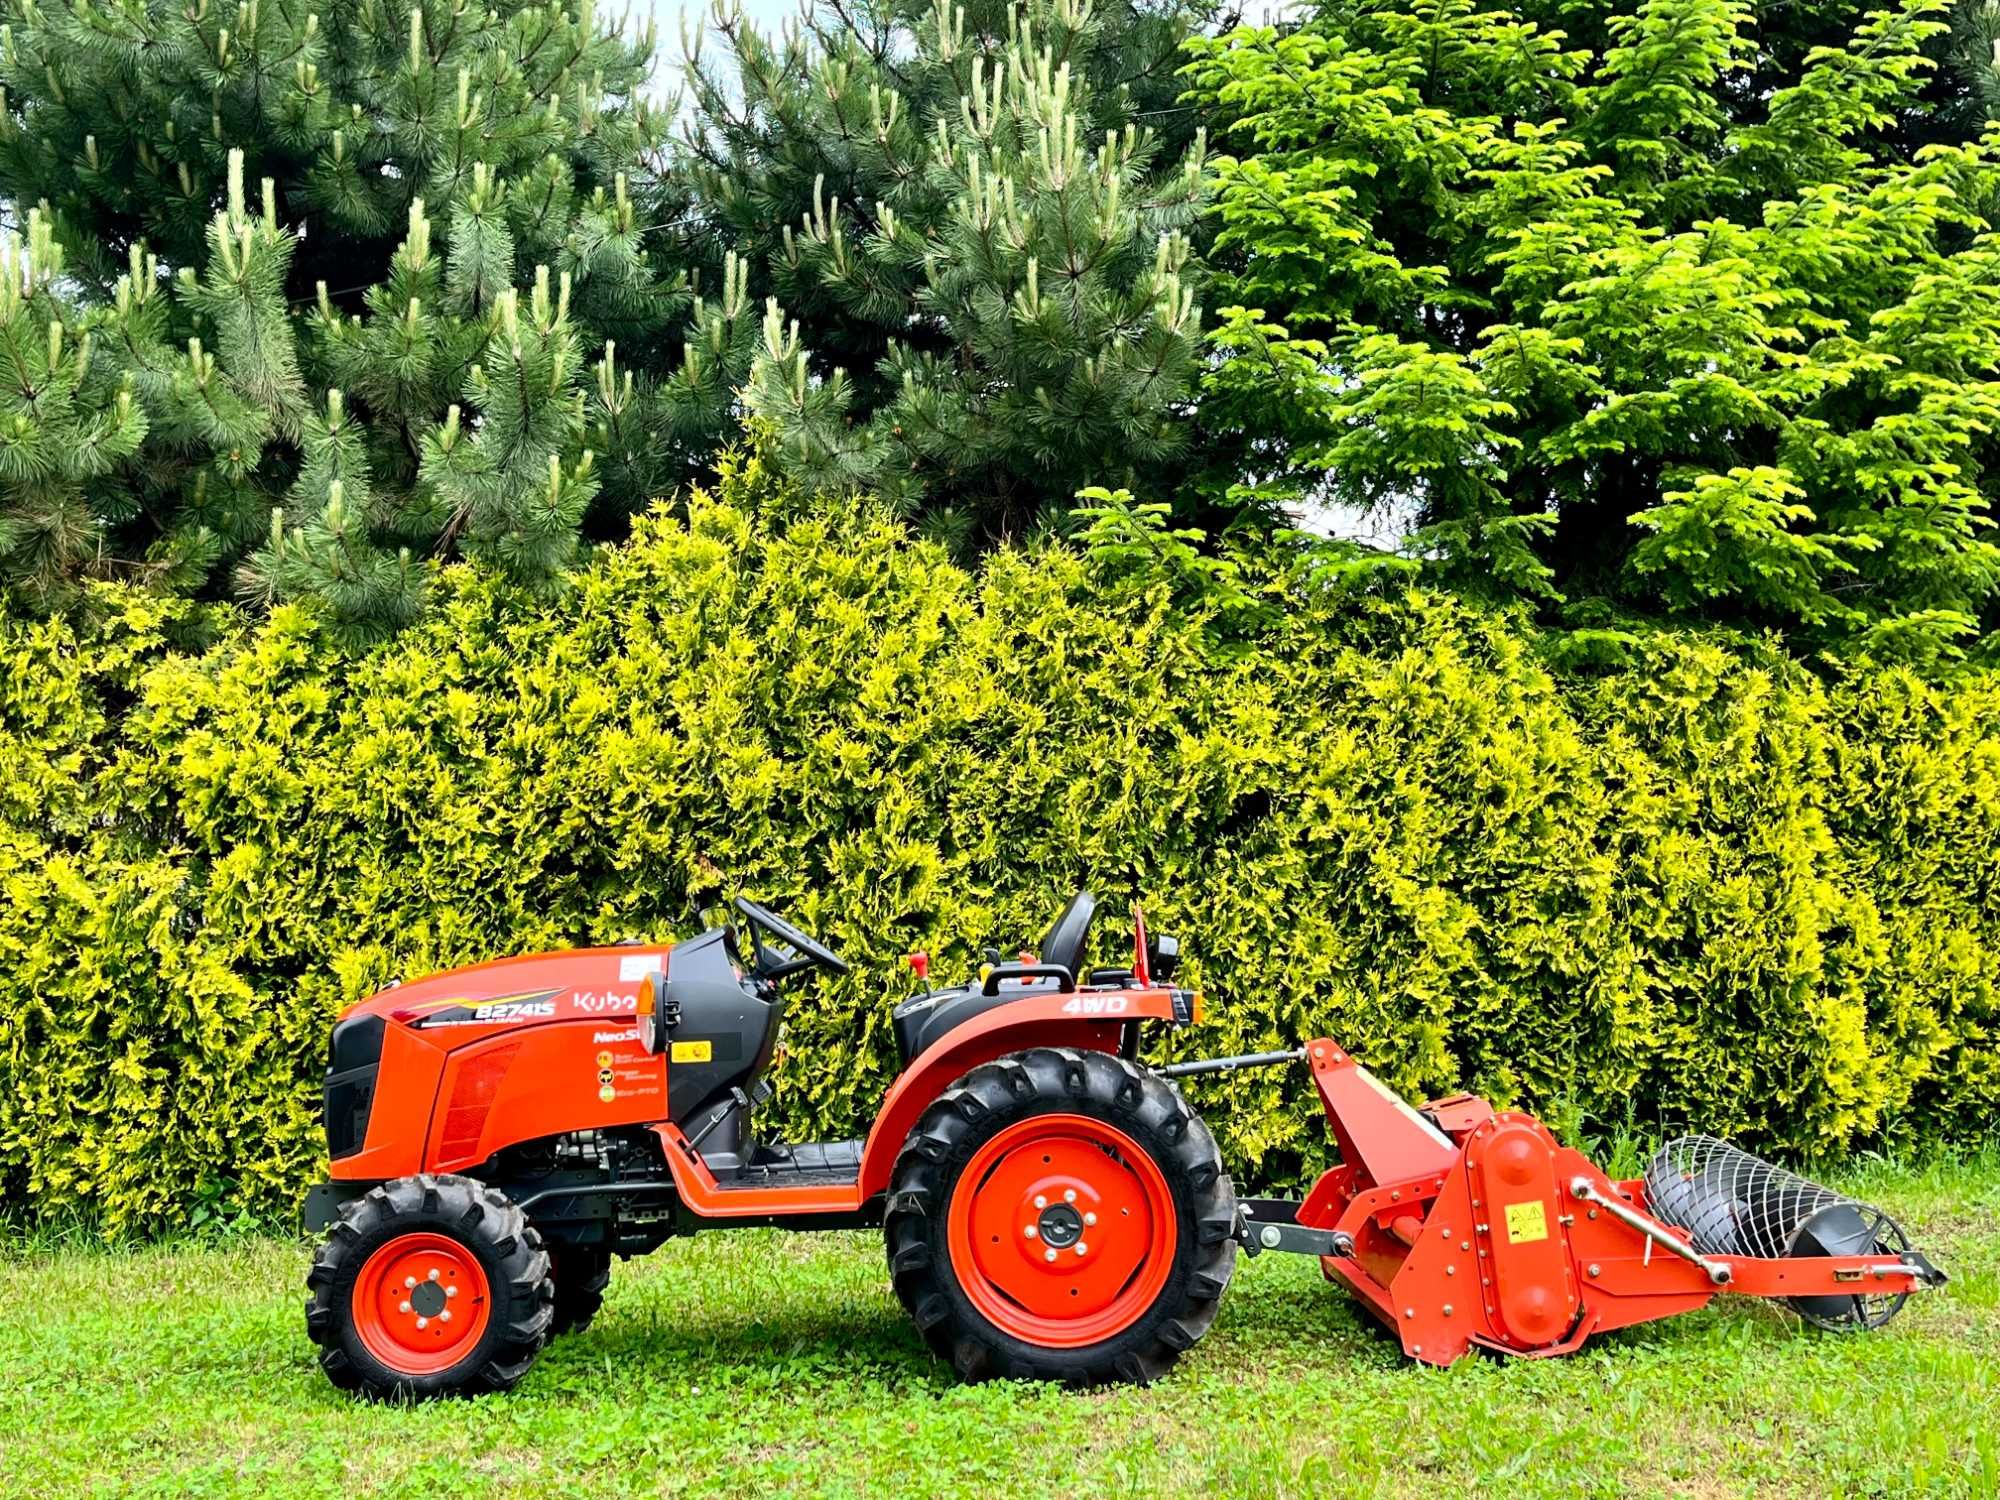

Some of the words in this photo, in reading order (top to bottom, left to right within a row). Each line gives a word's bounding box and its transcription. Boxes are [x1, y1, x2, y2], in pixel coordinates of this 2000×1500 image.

[573, 991, 637, 1012] Kubo
[1061, 996, 1127, 1014] 4WD
[475, 1002, 556, 1019] B2741S
[593, 1029, 641, 1044] NeoS
